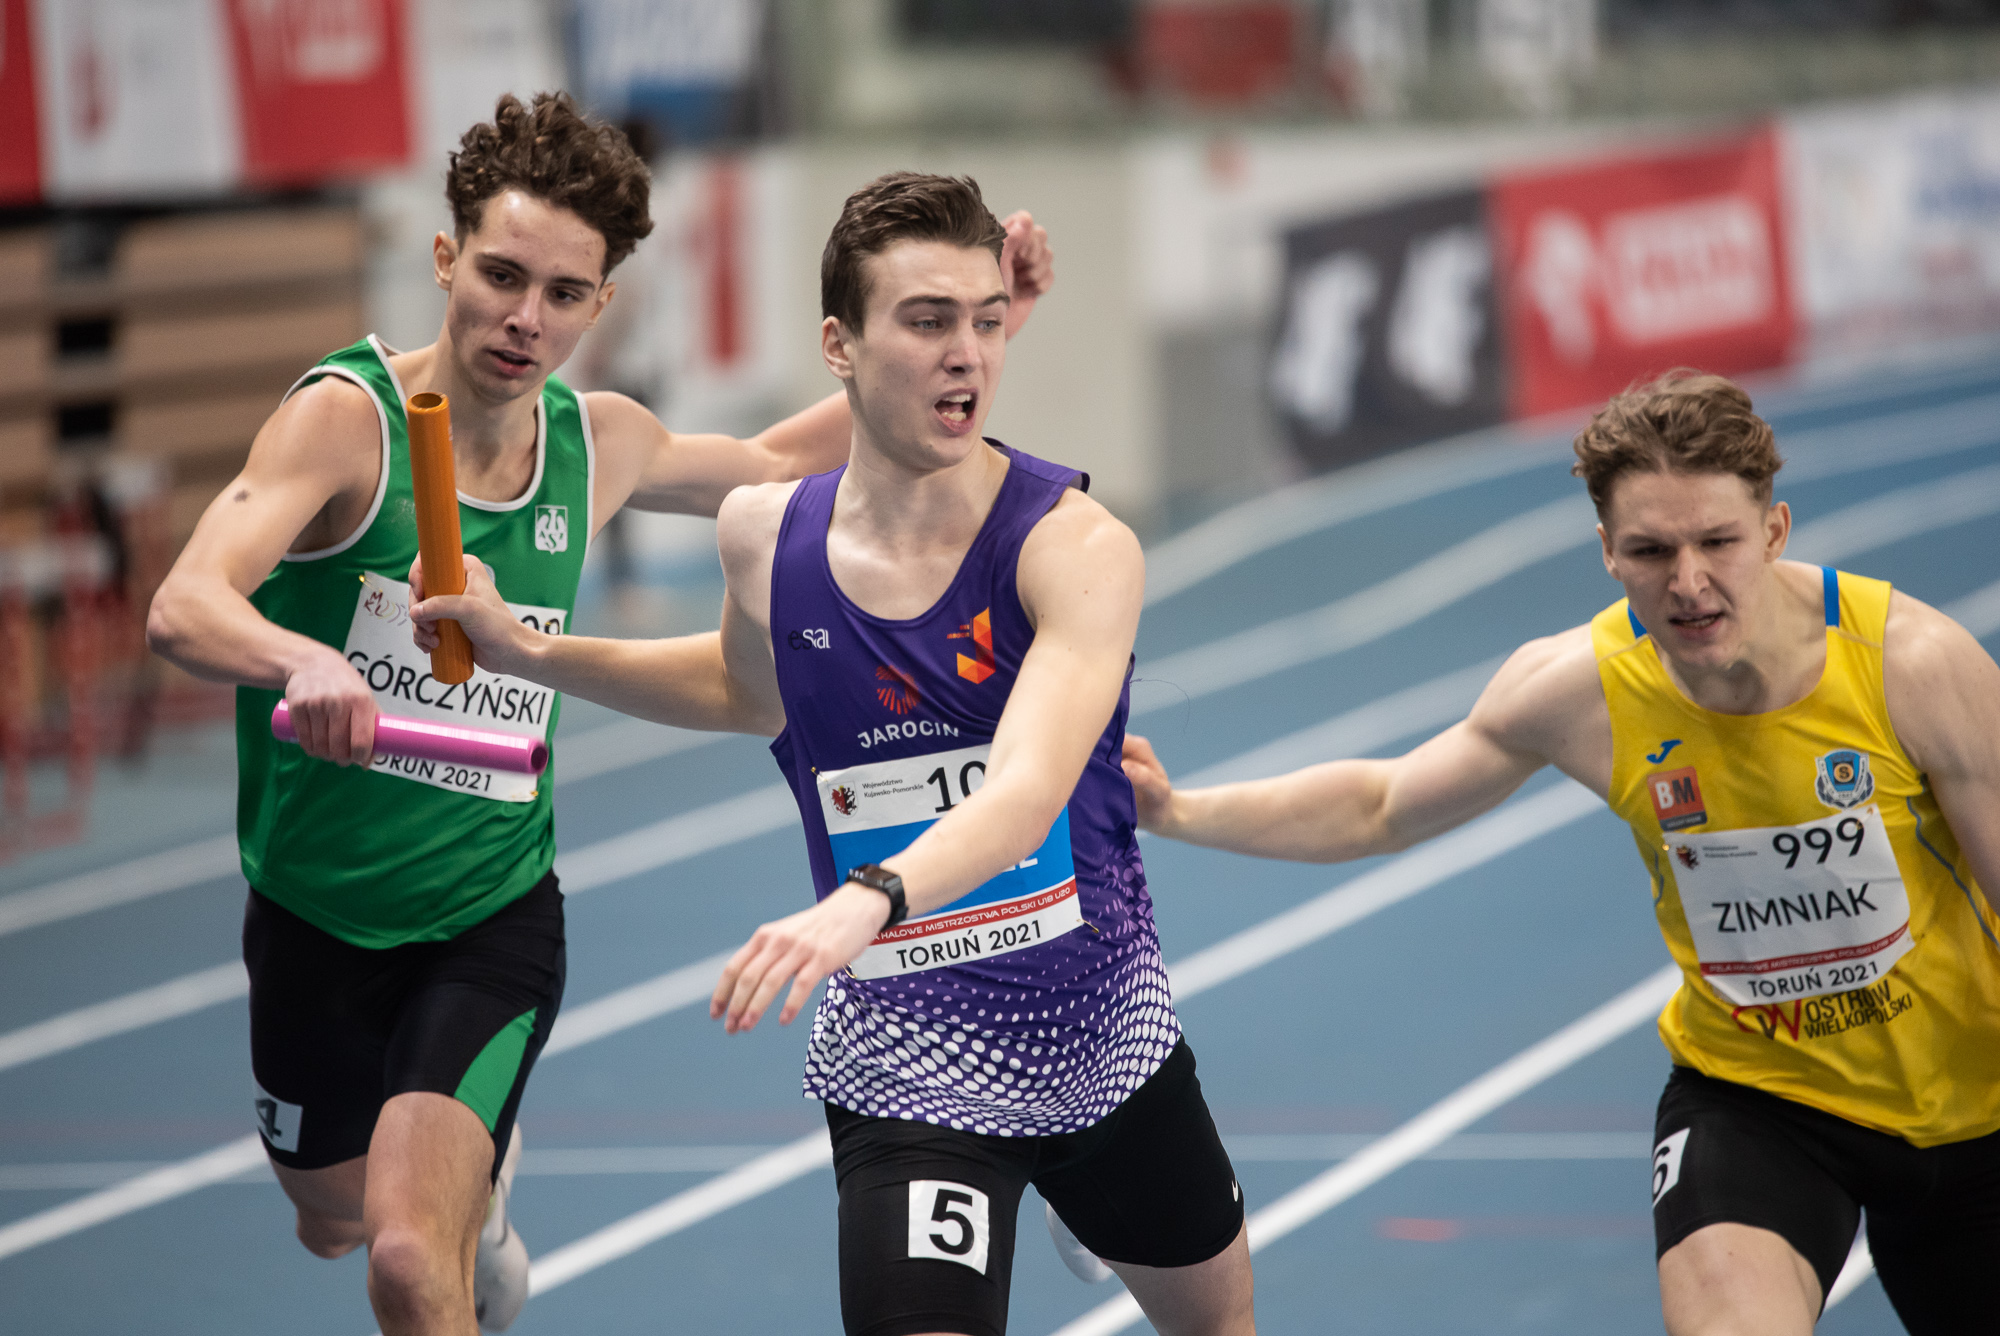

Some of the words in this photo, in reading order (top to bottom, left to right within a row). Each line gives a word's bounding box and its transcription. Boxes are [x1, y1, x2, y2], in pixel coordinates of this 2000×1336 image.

[347, 651, 547, 724] GÓRCZYŃSKI
[857, 719, 959, 748] JAROCIN
[441, 766, 492, 792] 2021
[1655, 776, 1695, 809] BM
[1772, 816, 1865, 870] 999
[880, 926, 923, 940] HALOWE
[925, 910, 1000, 932] MISTRZOSTWA
[1001, 901, 1036, 916] POLSKI
[1037, 894, 1054, 907] U18
[1054, 887, 1071, 900] U20
[1711, 882, 1878, 933] ZIMNIAK
[896, 929, 981, 969] TORUŃ
[988, 919, 1041, 952] 2021
[1748, 968, 1823, 998] TORUŃ
[1828, 959, 1879, 987] 2021
[1803, 992, 1913, 1039] WIELKOPOLSKI
[929, 1188, 975, 1256] 5
